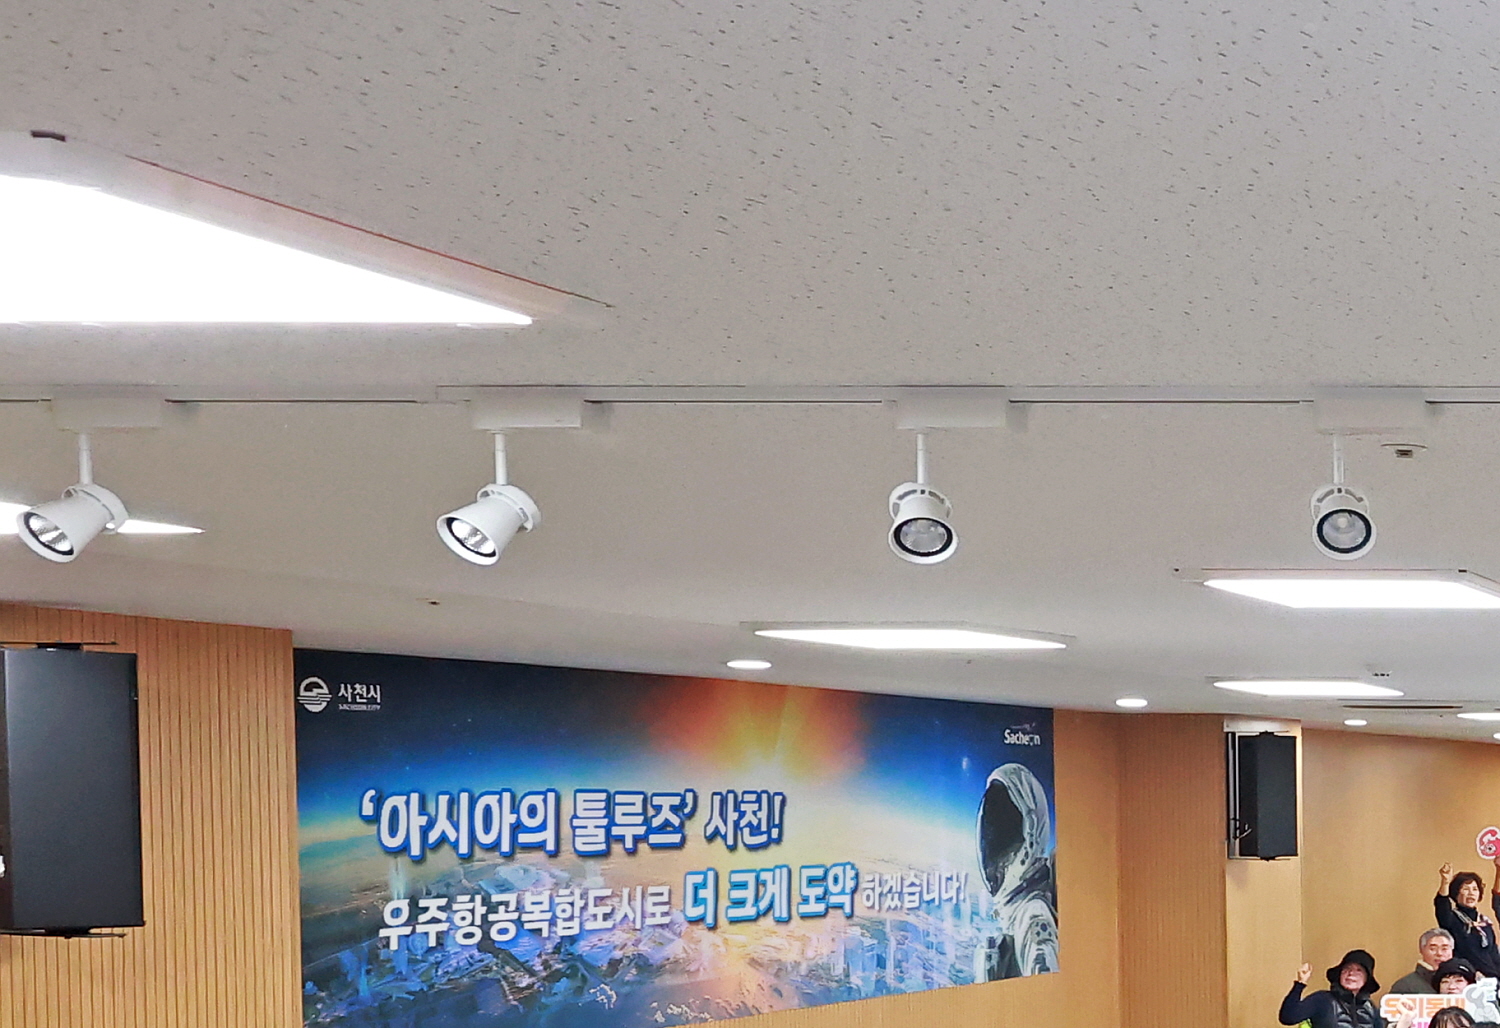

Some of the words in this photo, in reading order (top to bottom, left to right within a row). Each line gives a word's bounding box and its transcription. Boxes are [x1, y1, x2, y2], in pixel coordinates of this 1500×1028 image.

[338, 683, 381, 703] 사천시
[703, 790, 785, 848] 사천!
[378, 884, 672, 950] 우주항공복합도시로
[683, 869, 718, 928] 더
[726, 865, 789, 923] 크게
[796, 863, 857, 918] 도약
[861, 869, 969, 912] 하겠습니다!
